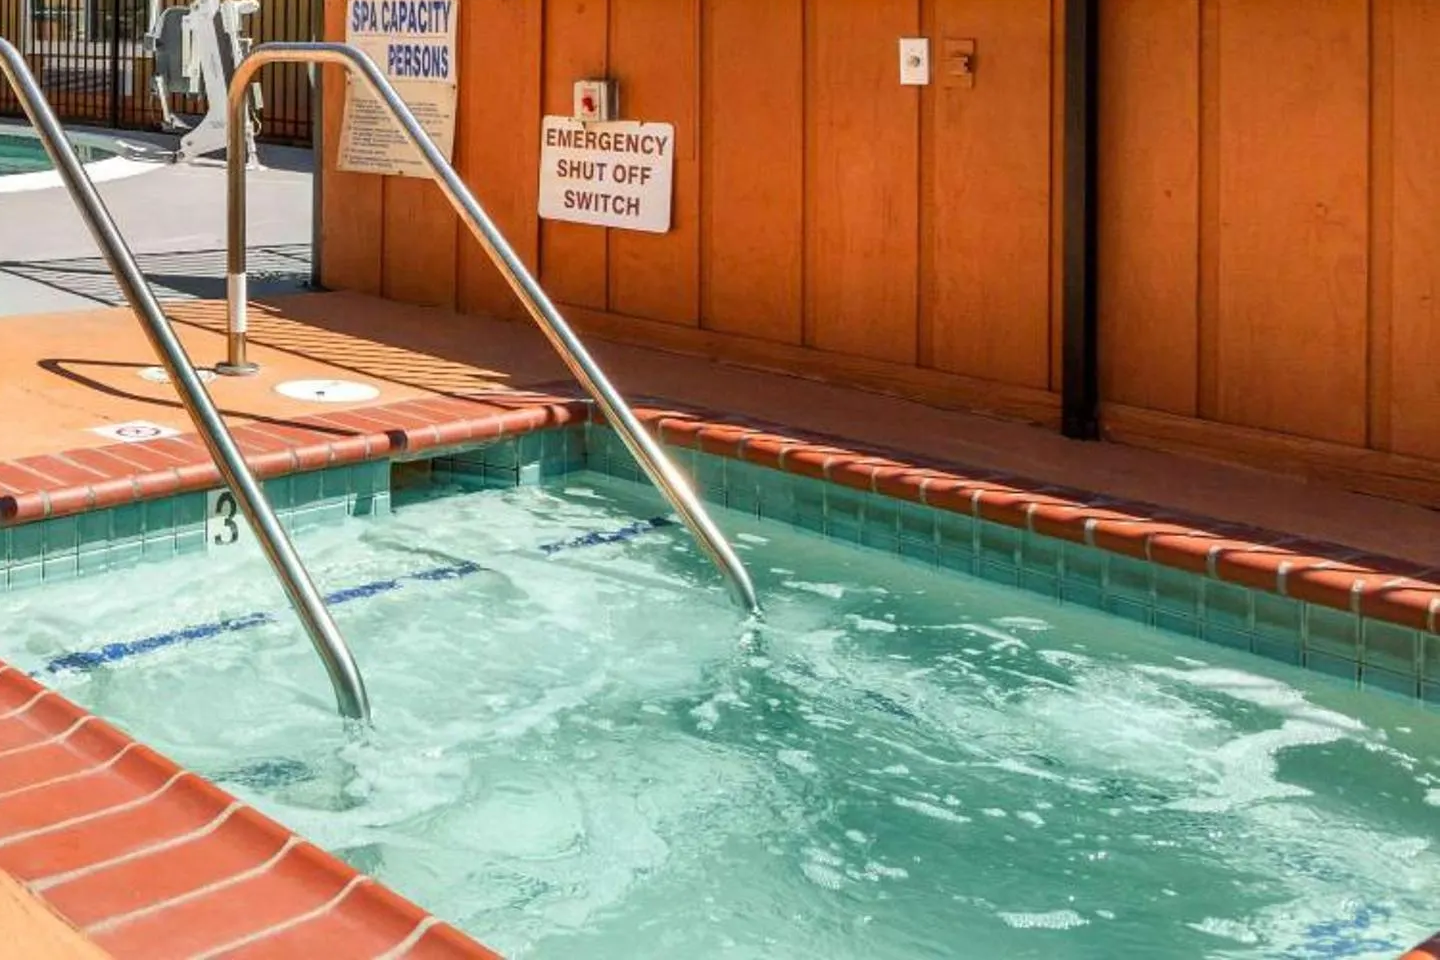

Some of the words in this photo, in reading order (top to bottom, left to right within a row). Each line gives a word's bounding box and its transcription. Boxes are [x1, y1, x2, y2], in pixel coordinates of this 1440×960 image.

[353, 0, 377, 32] SPA
[382, 0, 452, 33] CAPACITY
[388, 44, 448, 80] PERSONS
[546, 128, 668, 156] EMERGENCY
[556, 159, 607, 182] SHUT
[612, 164, 653, 185] OFF
[563, 189, 641, 216] SWITCH
[215, 491, 239, 546] 3
